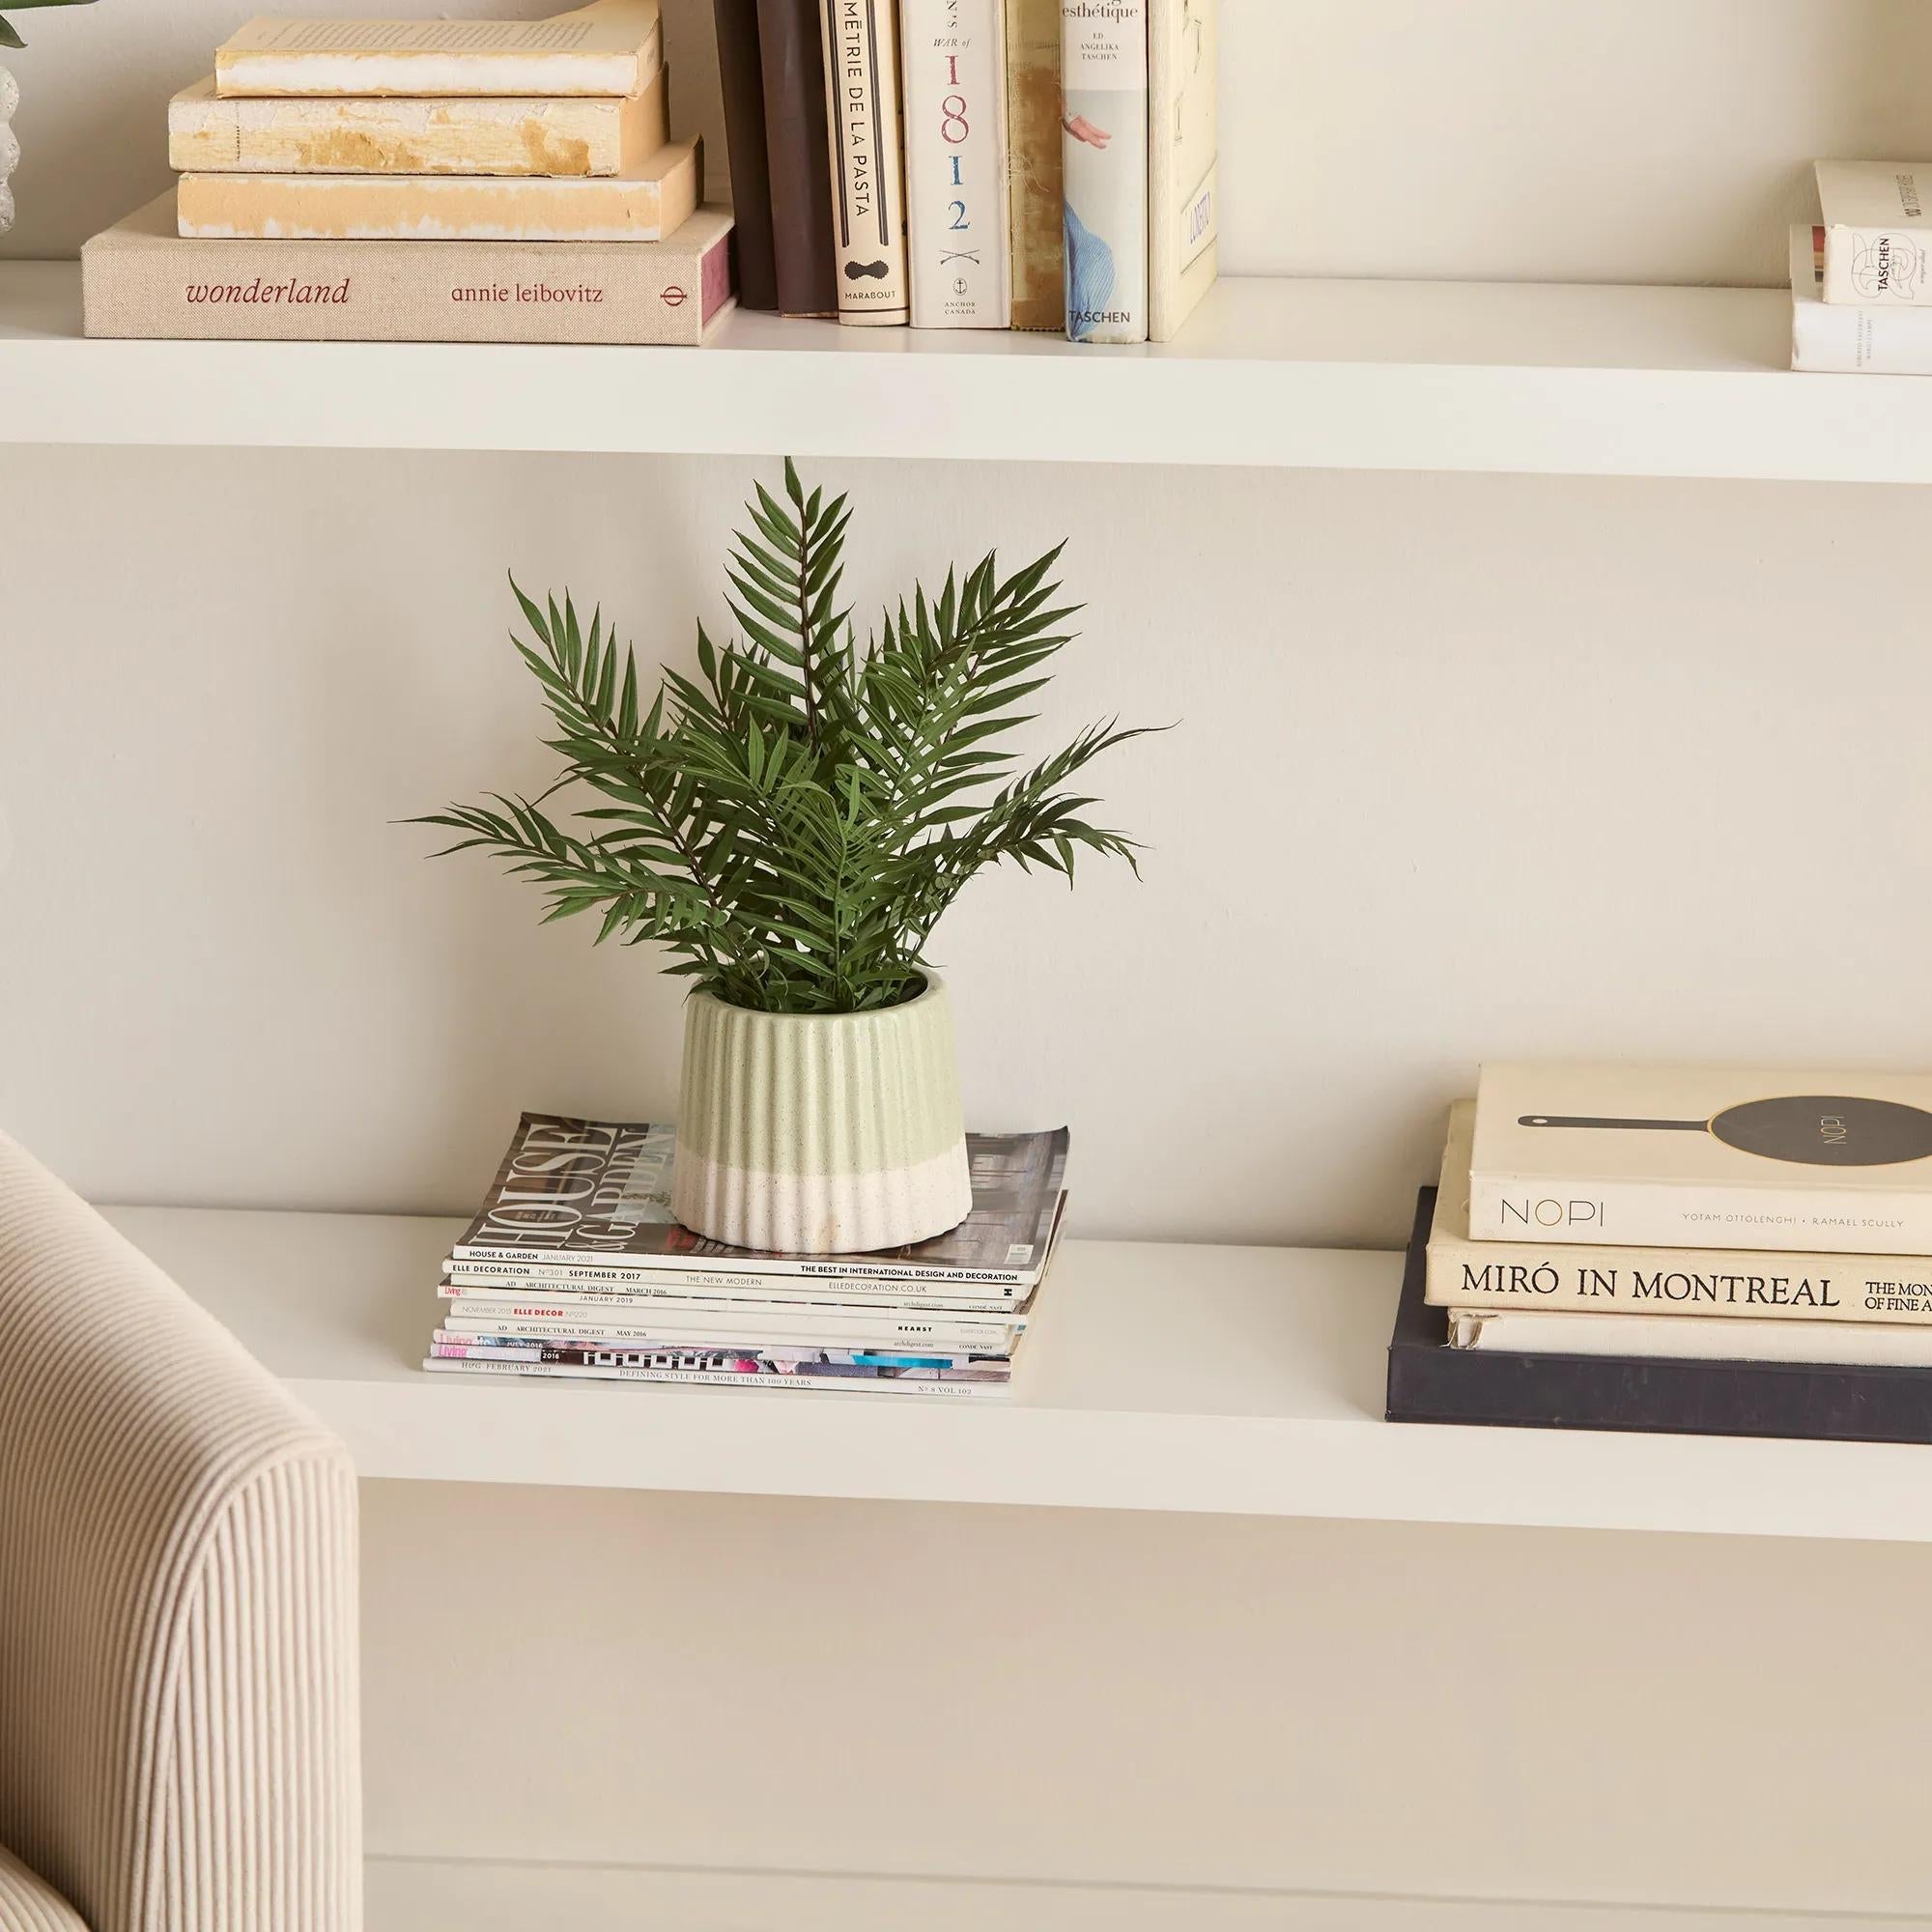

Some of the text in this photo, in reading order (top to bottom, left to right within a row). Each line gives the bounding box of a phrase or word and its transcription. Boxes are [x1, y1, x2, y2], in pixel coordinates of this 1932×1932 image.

[1062, 3, 1138, 24] esthétique
[933, 39, 971, 48] WAR of
[1081, 43, 1120, 51] ANGELIKA
[848, 87, 865, 113] DE
[850, 122, 866, 147] LA
[852, 155, 869, 216] PASTA
[1877, 238, 1890, 292] TASCHEN
[185, 277, 351, 303] wonderland
[451, 283, 604, 302] annie leibovitz
[844, 290, 896, 299] MARABOUT
[1068, 310, 1131, 324] TASCHEN
[1820, 1115, 1848, 1145] NOPI
[469, 1123, 618, 1249] HOUSE
[1501, 1199, 1604, 1227] NOPI
[1683, 1212, 1906, 1228] YOTAM OTTOLENGHI RAMAEL SCULLY
[469, 1250, 497, 1259] HOUSE
[473, 1265, 530, 1275] DECORATION
[568, 1269, 617, 1279] SEPTEMBER
[817, 1265, 838, 1274] BEST
[849, 1266, 914, 1277] INTERNATIONAL
[965, 1272, 1018, 1281] DECORATION
[525, 1282, 585, 1291] ARCHITECTURAL
[828, 1282, 927, 1293] ELLEDECORATION.CO.UK
[1461, 1261, 1841, 1308] MIRÓ IN MONTREAL
[1864, 1281, 1896, 1296] THE
[579, 1293, 614, 1302] JANUARY
[1864, 1296, 1886, 1311] OF
[1887, 1297, 1919, 1312] FINE
[517, 1325, 576, 1334] ARCHITECTURAL
[486, 1363, 530, 1373] FEBRUARY
[619, 1369, 663, 1378] DEFINING
[664, 1371, 693, 1380] STYLE
[741, 1376, 766, 1384] THAN
